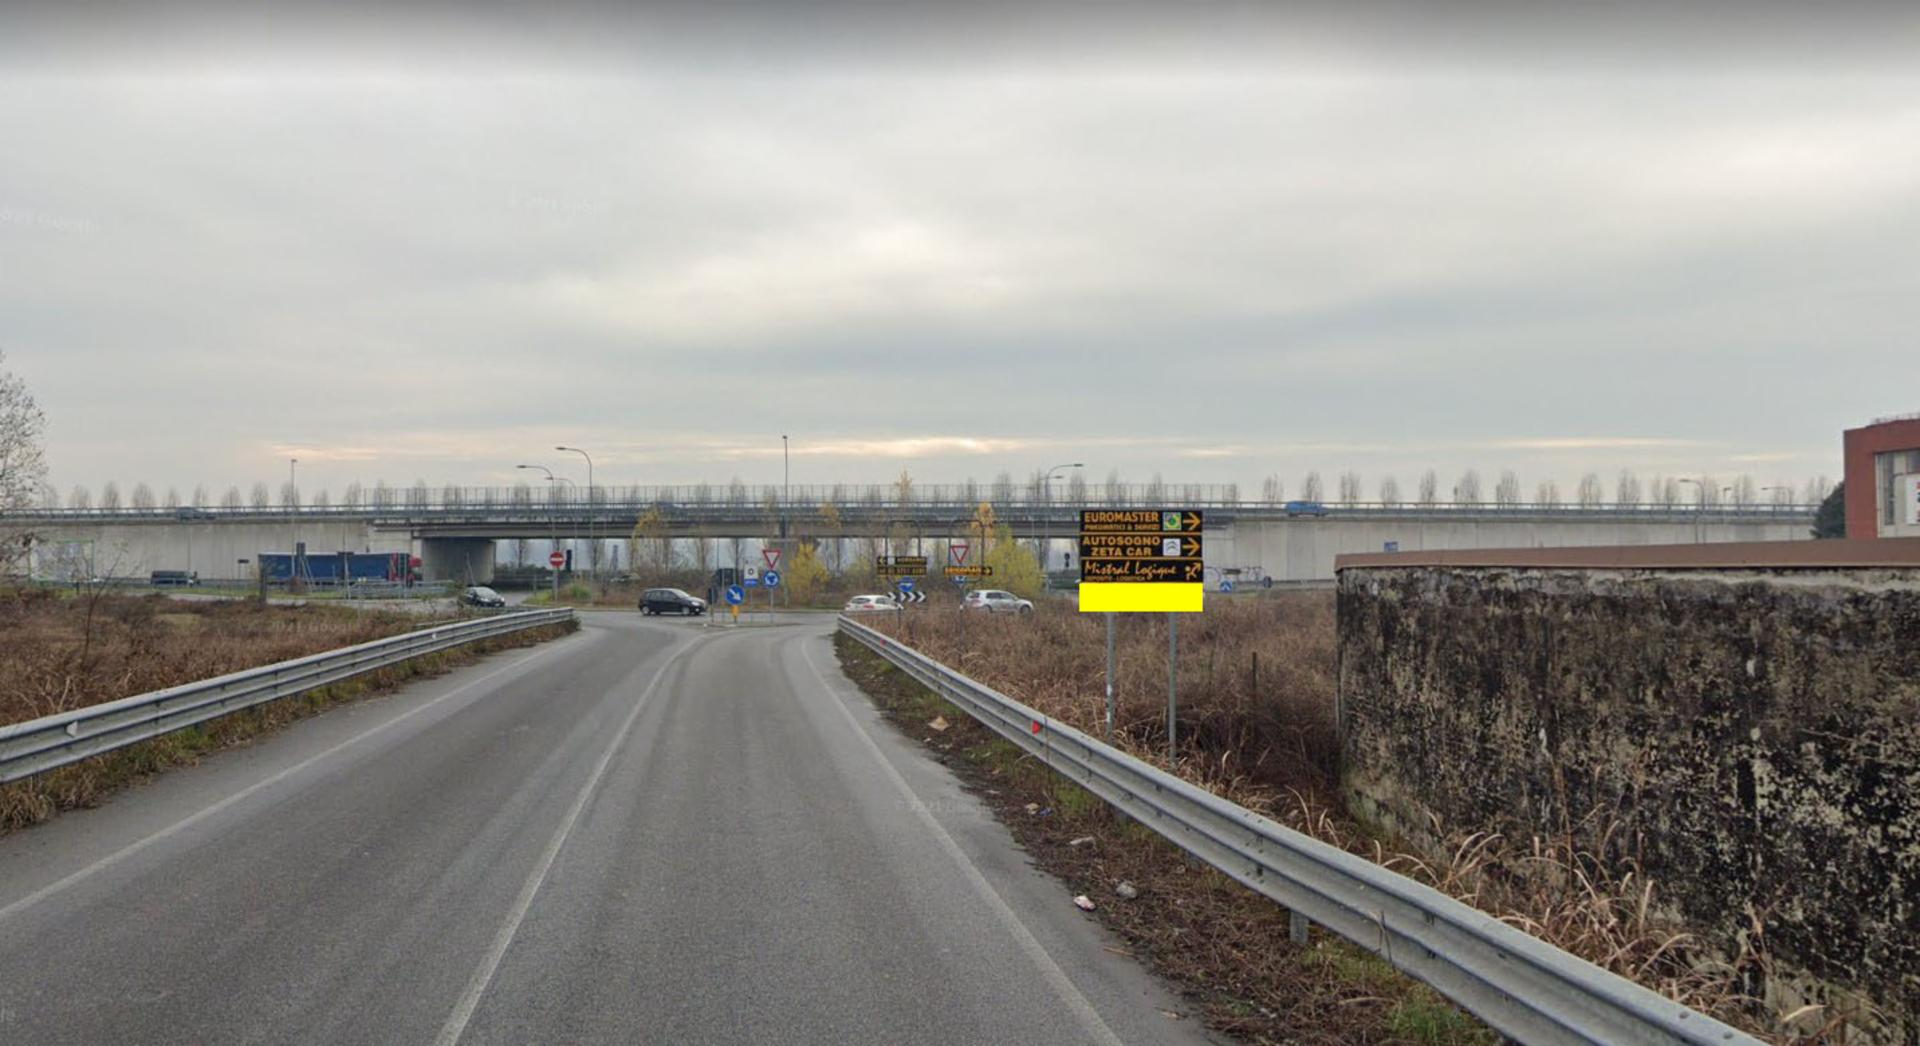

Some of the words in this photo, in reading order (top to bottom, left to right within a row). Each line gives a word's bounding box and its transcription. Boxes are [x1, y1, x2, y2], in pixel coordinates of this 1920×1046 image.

[1084, 511, 1159, 523] EUROMASTER
[1082, 536, 1160, 546] AUTOSOGNO
[1091, 547, 1122, 556] ZETA
[1126, 547, 1152, 556] CAR
[1084, 561, 1130, 574] Mistral
[1135, 561, 1177, 579] Logique
